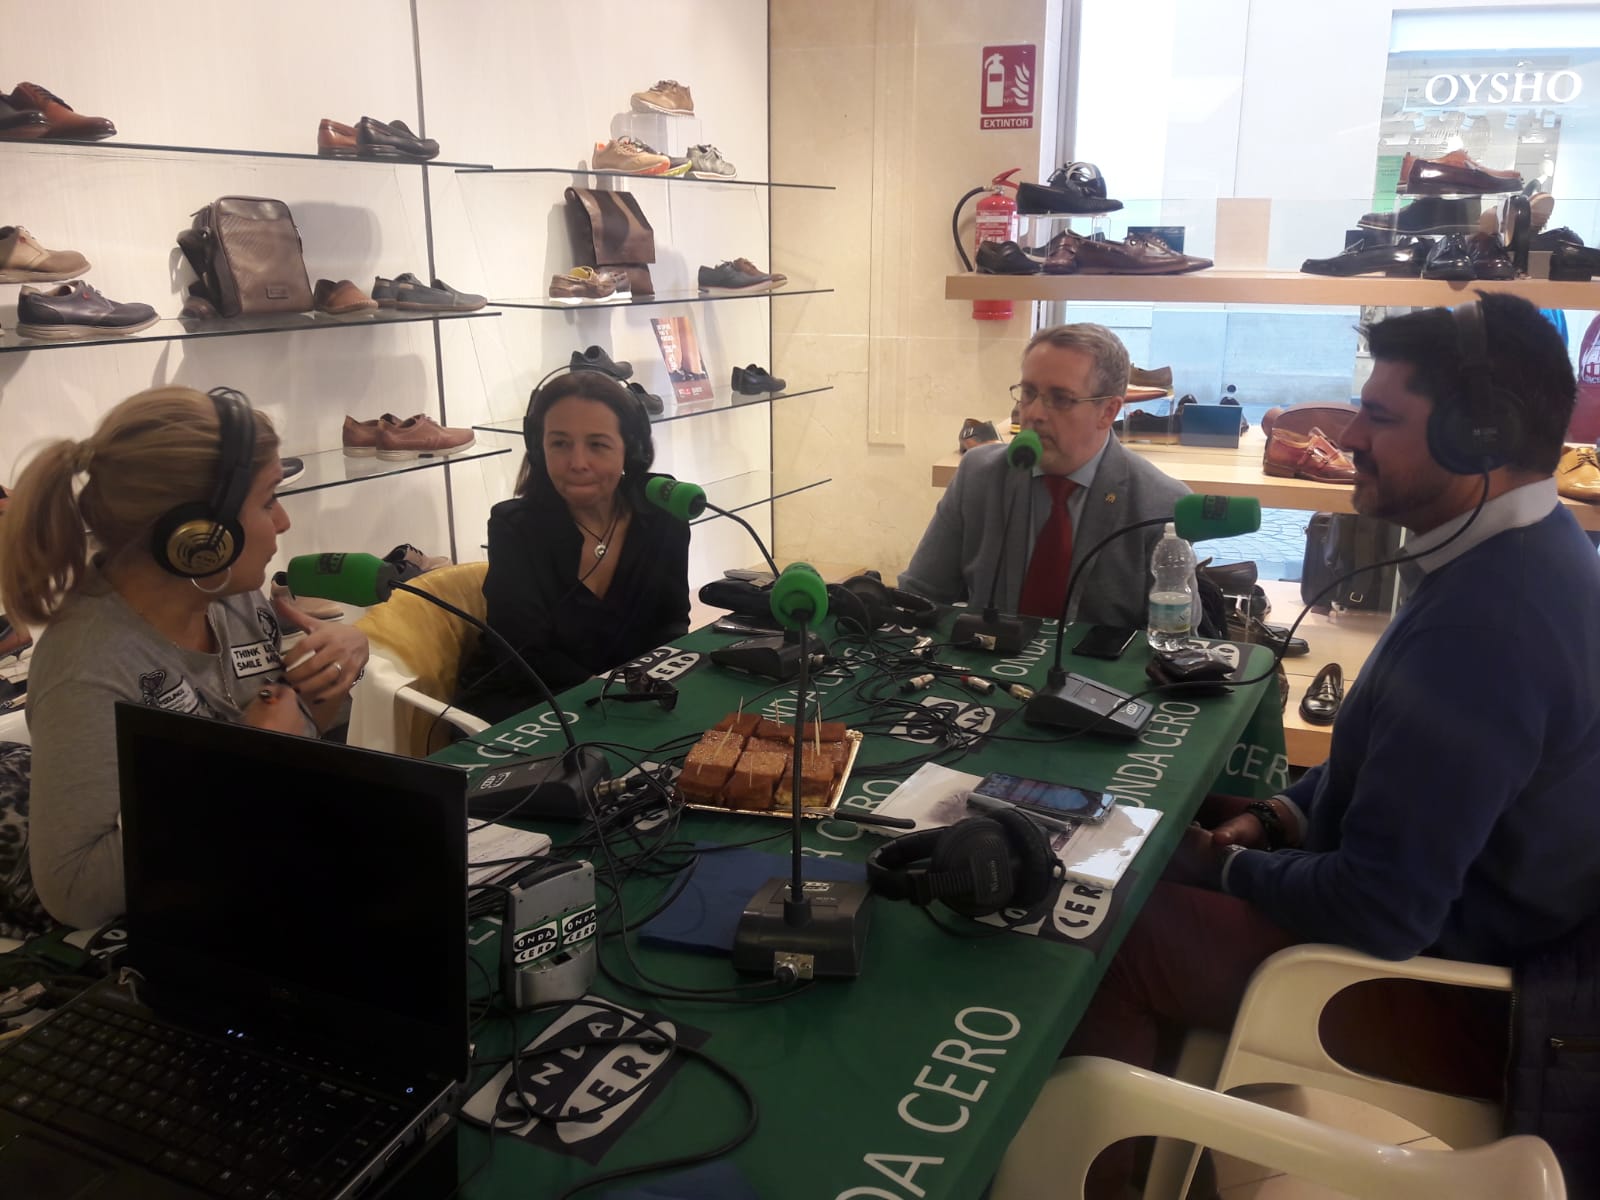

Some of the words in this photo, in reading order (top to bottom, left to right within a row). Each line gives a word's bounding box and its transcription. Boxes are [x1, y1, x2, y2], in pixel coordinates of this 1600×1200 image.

[1425, 70, 1583, 106] OYSHO
[983, 118, 1029, 129] EXTINTOR
[233, 647, 261, 659] THINK
[236, 658, 263, 671] SMILE
[1139, 701, 1201, 748] CERO
[476, 710, 580, 759] CERO
[1225, 742, 1290, 790] CER
[1058, 884, 1104, 929] CER
[567, 911, 596, 930] ONDA
[518, 930, 552, 947] ONDA
[568, 924, 596, 942] CERO
[520, 943, 552, 960] CERO
[897, 1006, 1021, 1133] CERO
